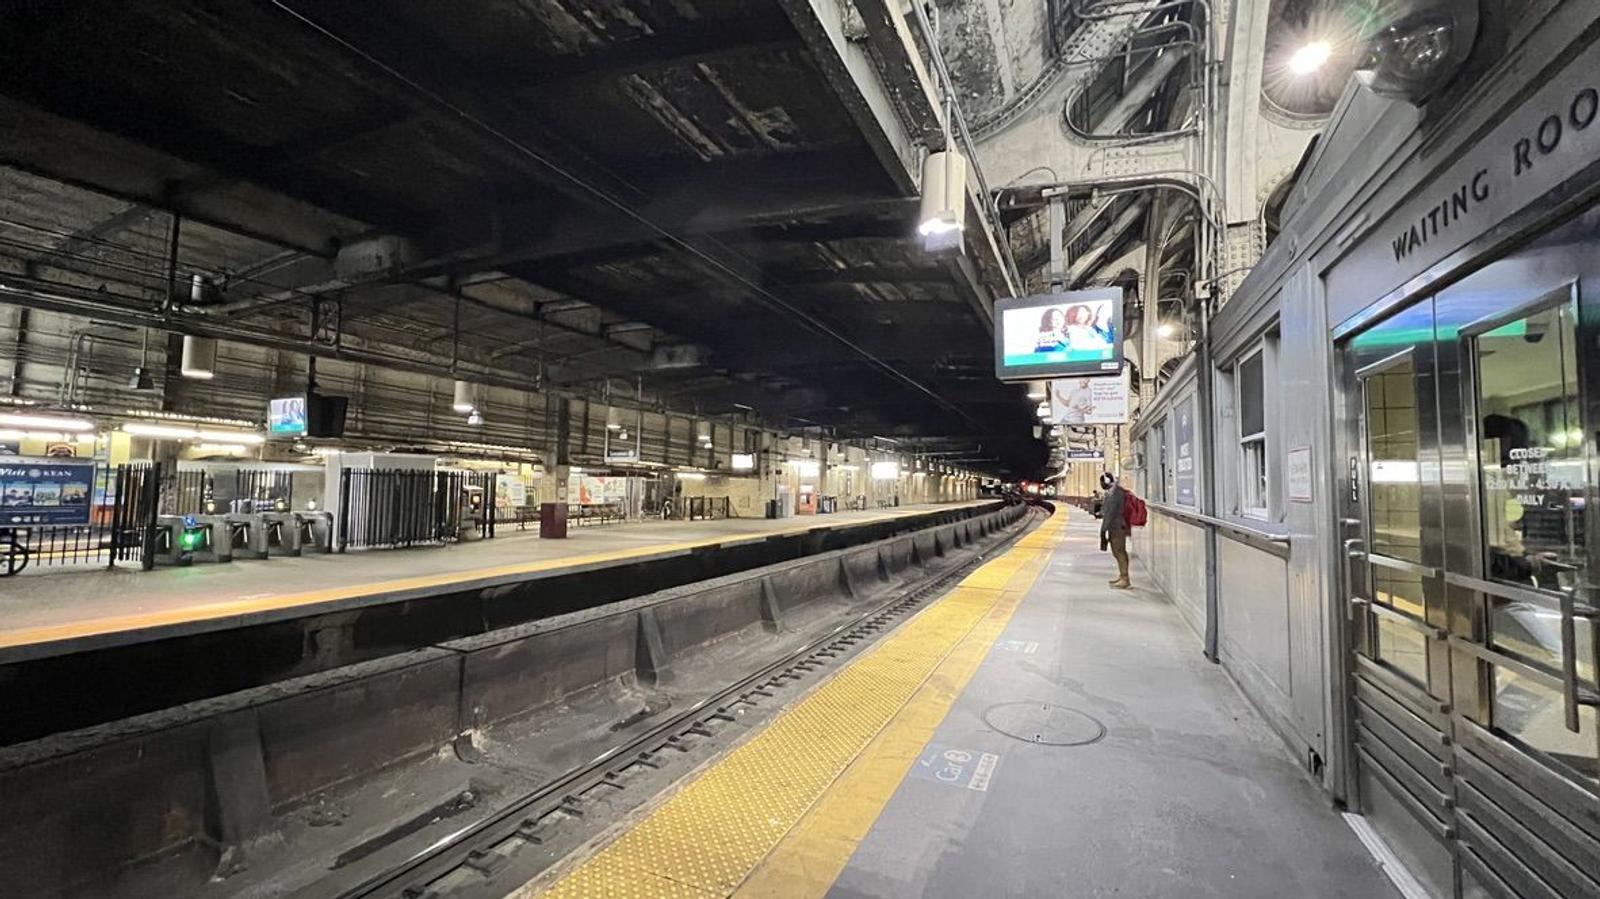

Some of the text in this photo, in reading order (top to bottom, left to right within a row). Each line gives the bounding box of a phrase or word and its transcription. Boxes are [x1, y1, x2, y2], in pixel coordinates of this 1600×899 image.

[1393, 169, 1489, 262] WAITING
[1516, 494, 1545, 506] DAILY
[935, 761, 962, 781] Car
